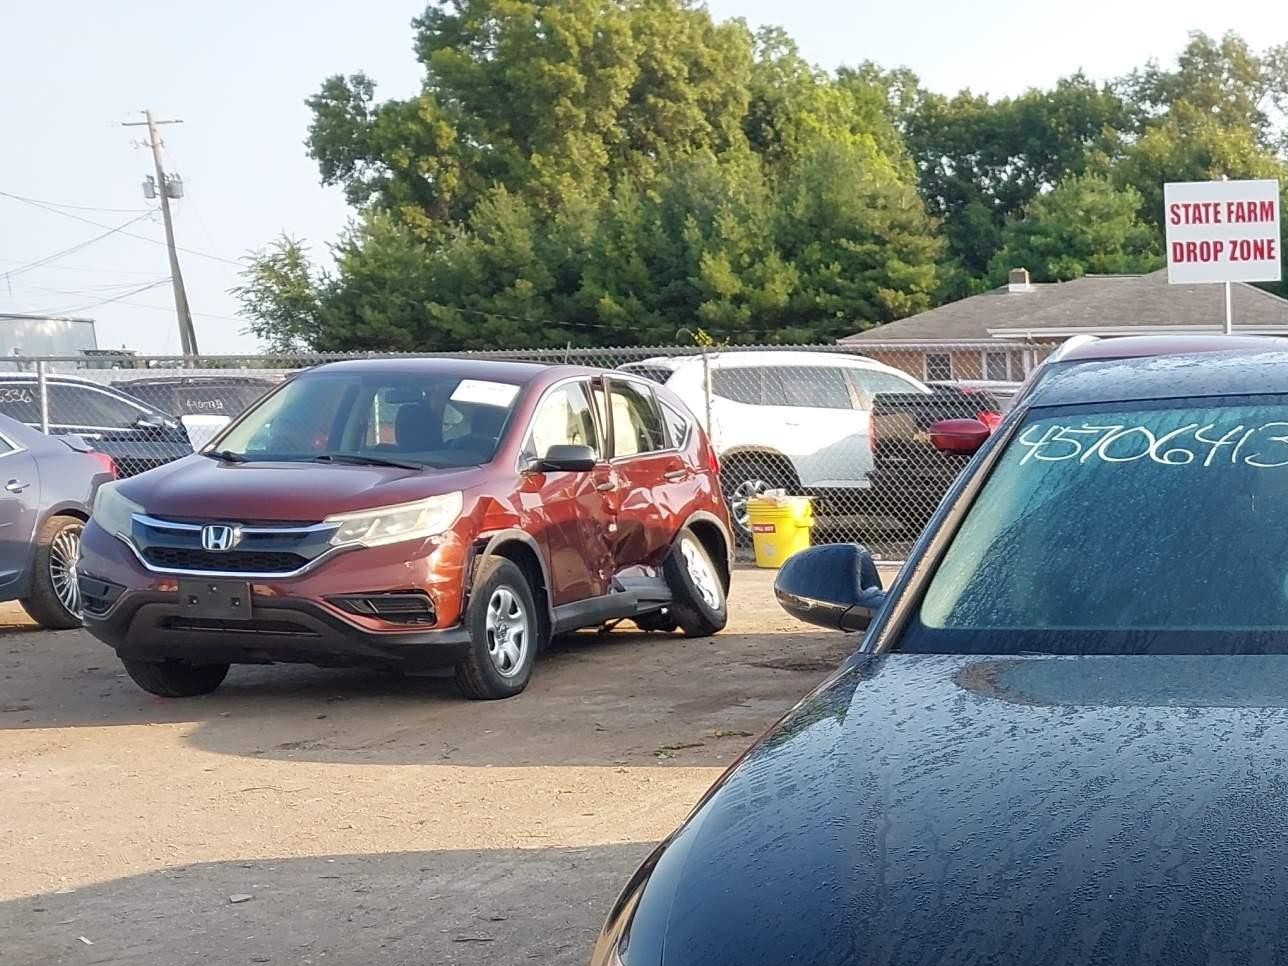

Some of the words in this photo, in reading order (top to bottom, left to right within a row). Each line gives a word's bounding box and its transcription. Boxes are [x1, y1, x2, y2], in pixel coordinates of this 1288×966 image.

[1170, 202, 1222, 225] STATE
[1226, 201, 1275, 224] FARM
[1171, 240, 1224, 263] DROP
[1229, 239, 1276, 262] ZONE
